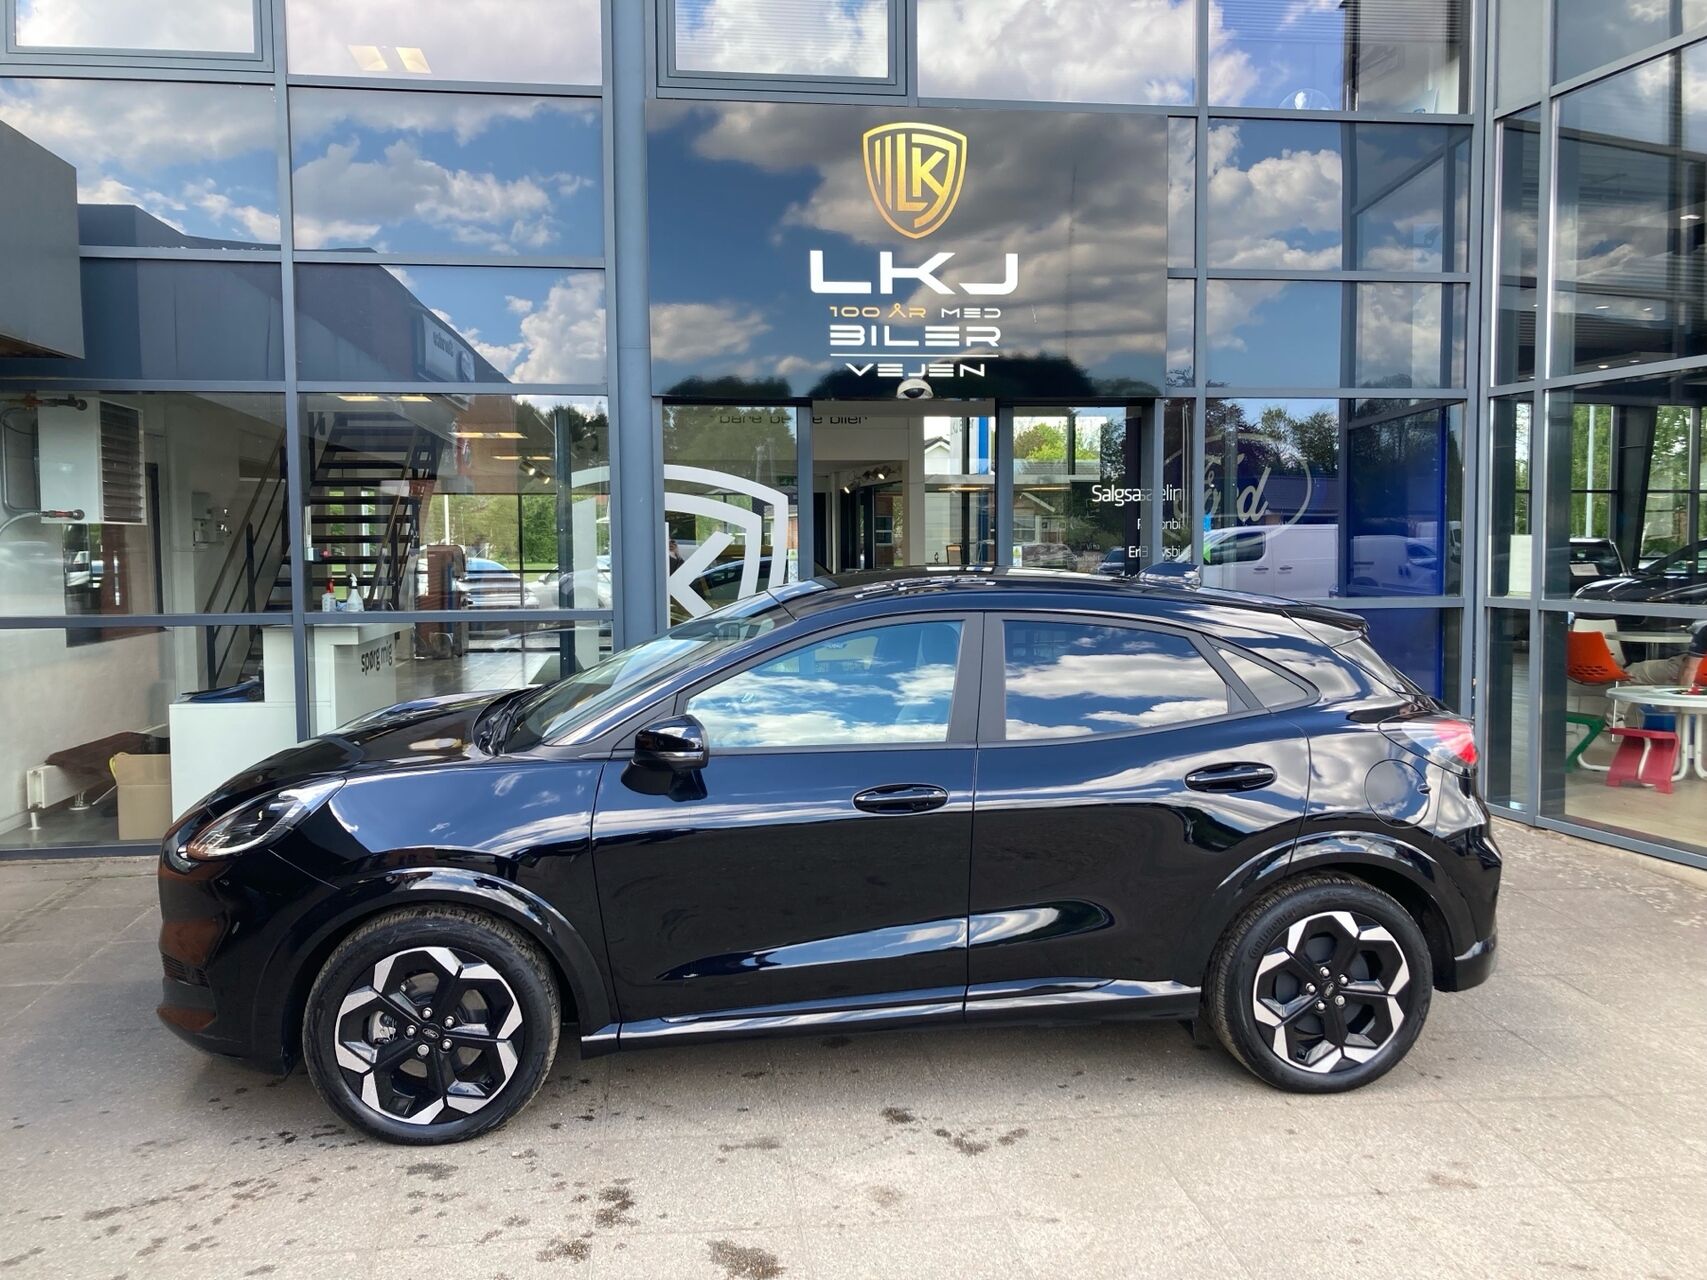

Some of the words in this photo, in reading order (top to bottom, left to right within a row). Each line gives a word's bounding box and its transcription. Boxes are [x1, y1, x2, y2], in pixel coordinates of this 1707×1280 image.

[810, 250, 1019, 295] LKJ
[830, 306, 881, 318] 100
[888, 303, 927, 318] ÅR
[941, 307, 1002, 318] MED
[830, 325, 1002, 347] BILER
[845, 363, 985, 377] VEJEN
